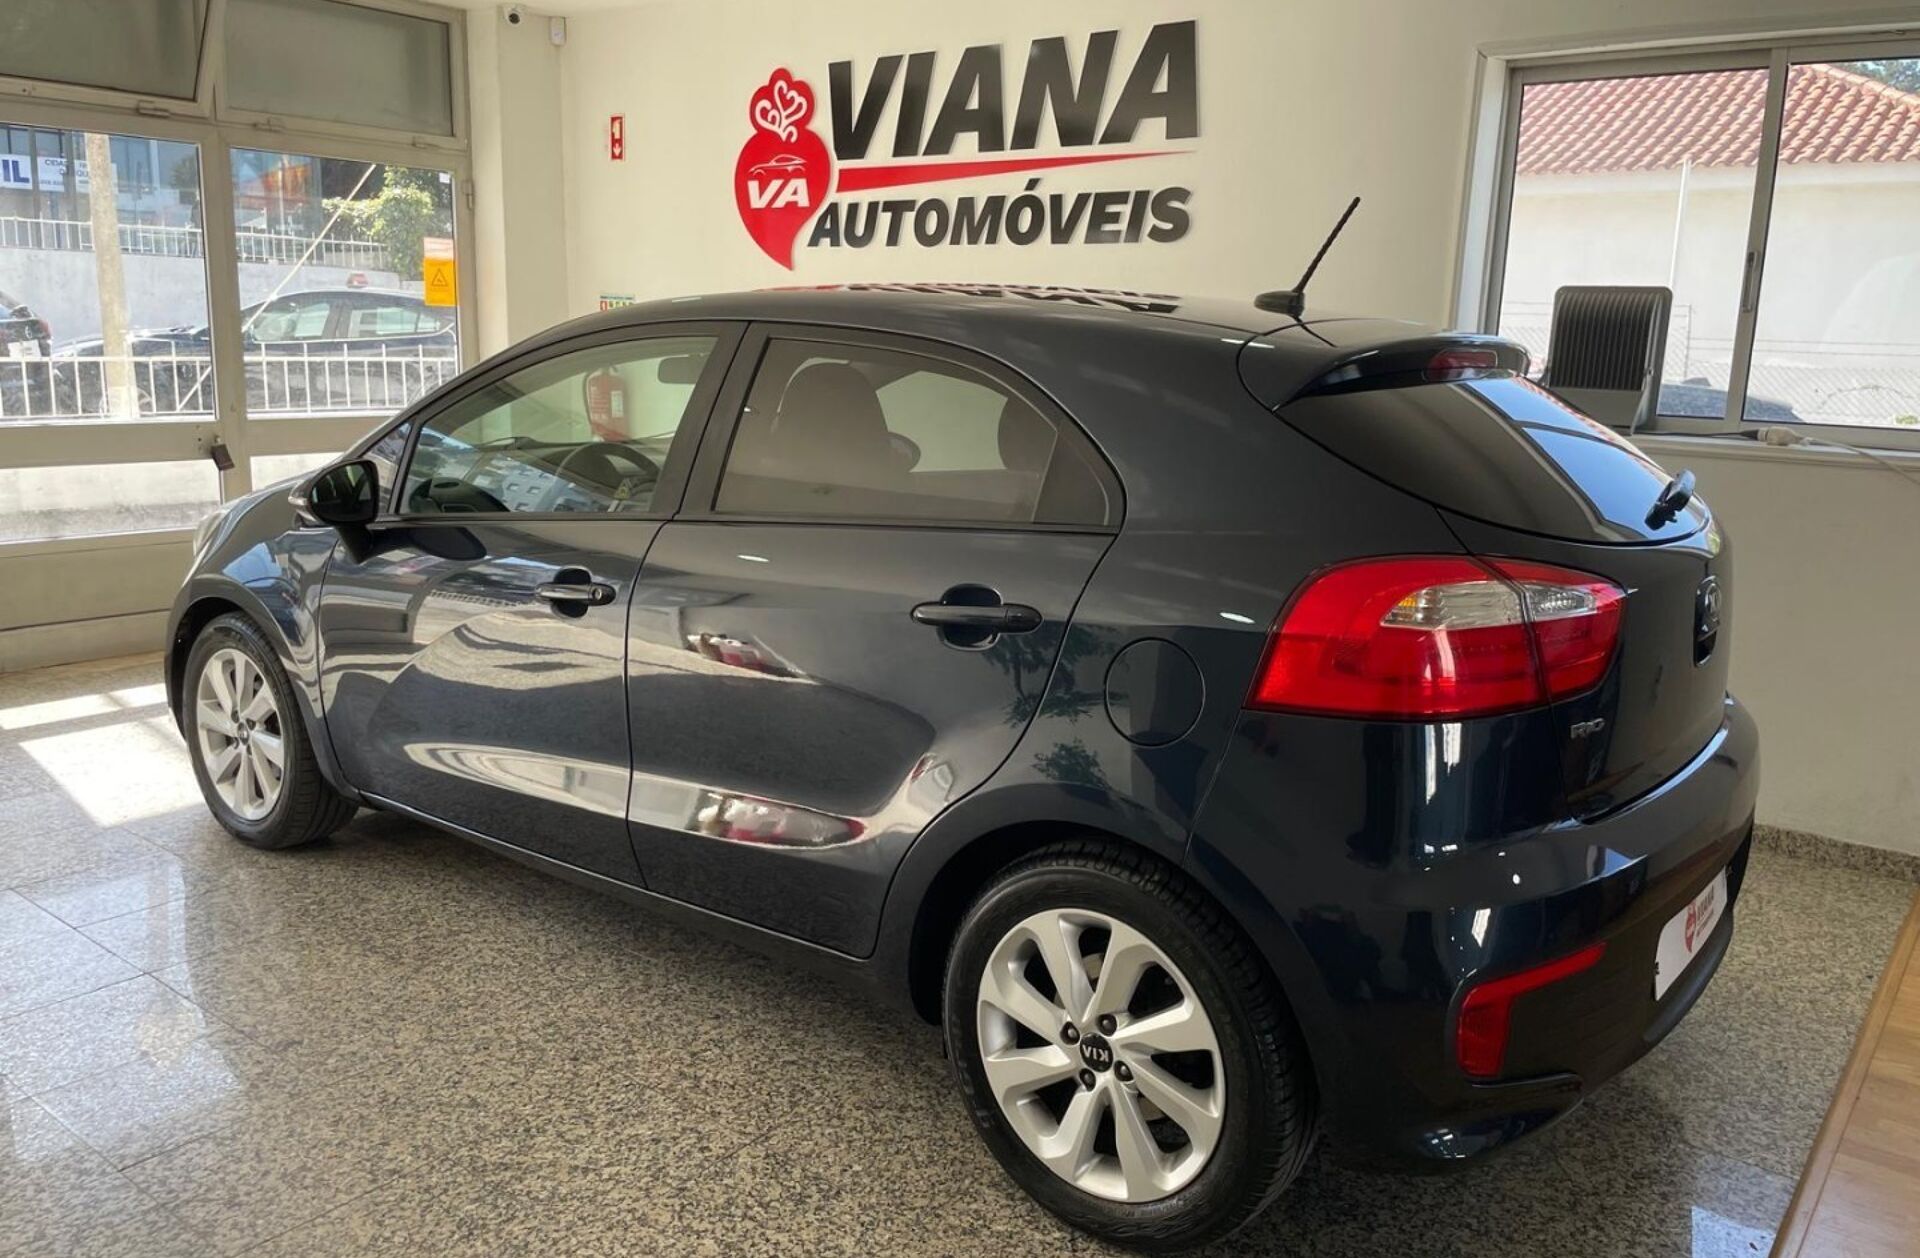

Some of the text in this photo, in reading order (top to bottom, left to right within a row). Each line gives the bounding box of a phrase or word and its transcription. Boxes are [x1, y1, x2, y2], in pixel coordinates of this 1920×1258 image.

[828, 20, 1200, 161] VIANA
[747, 178, 810, 209] VA
[807, 178, 1192, 248] AUTOMÓVEIS
[1081, 1044, 1110, 1063] KIA
